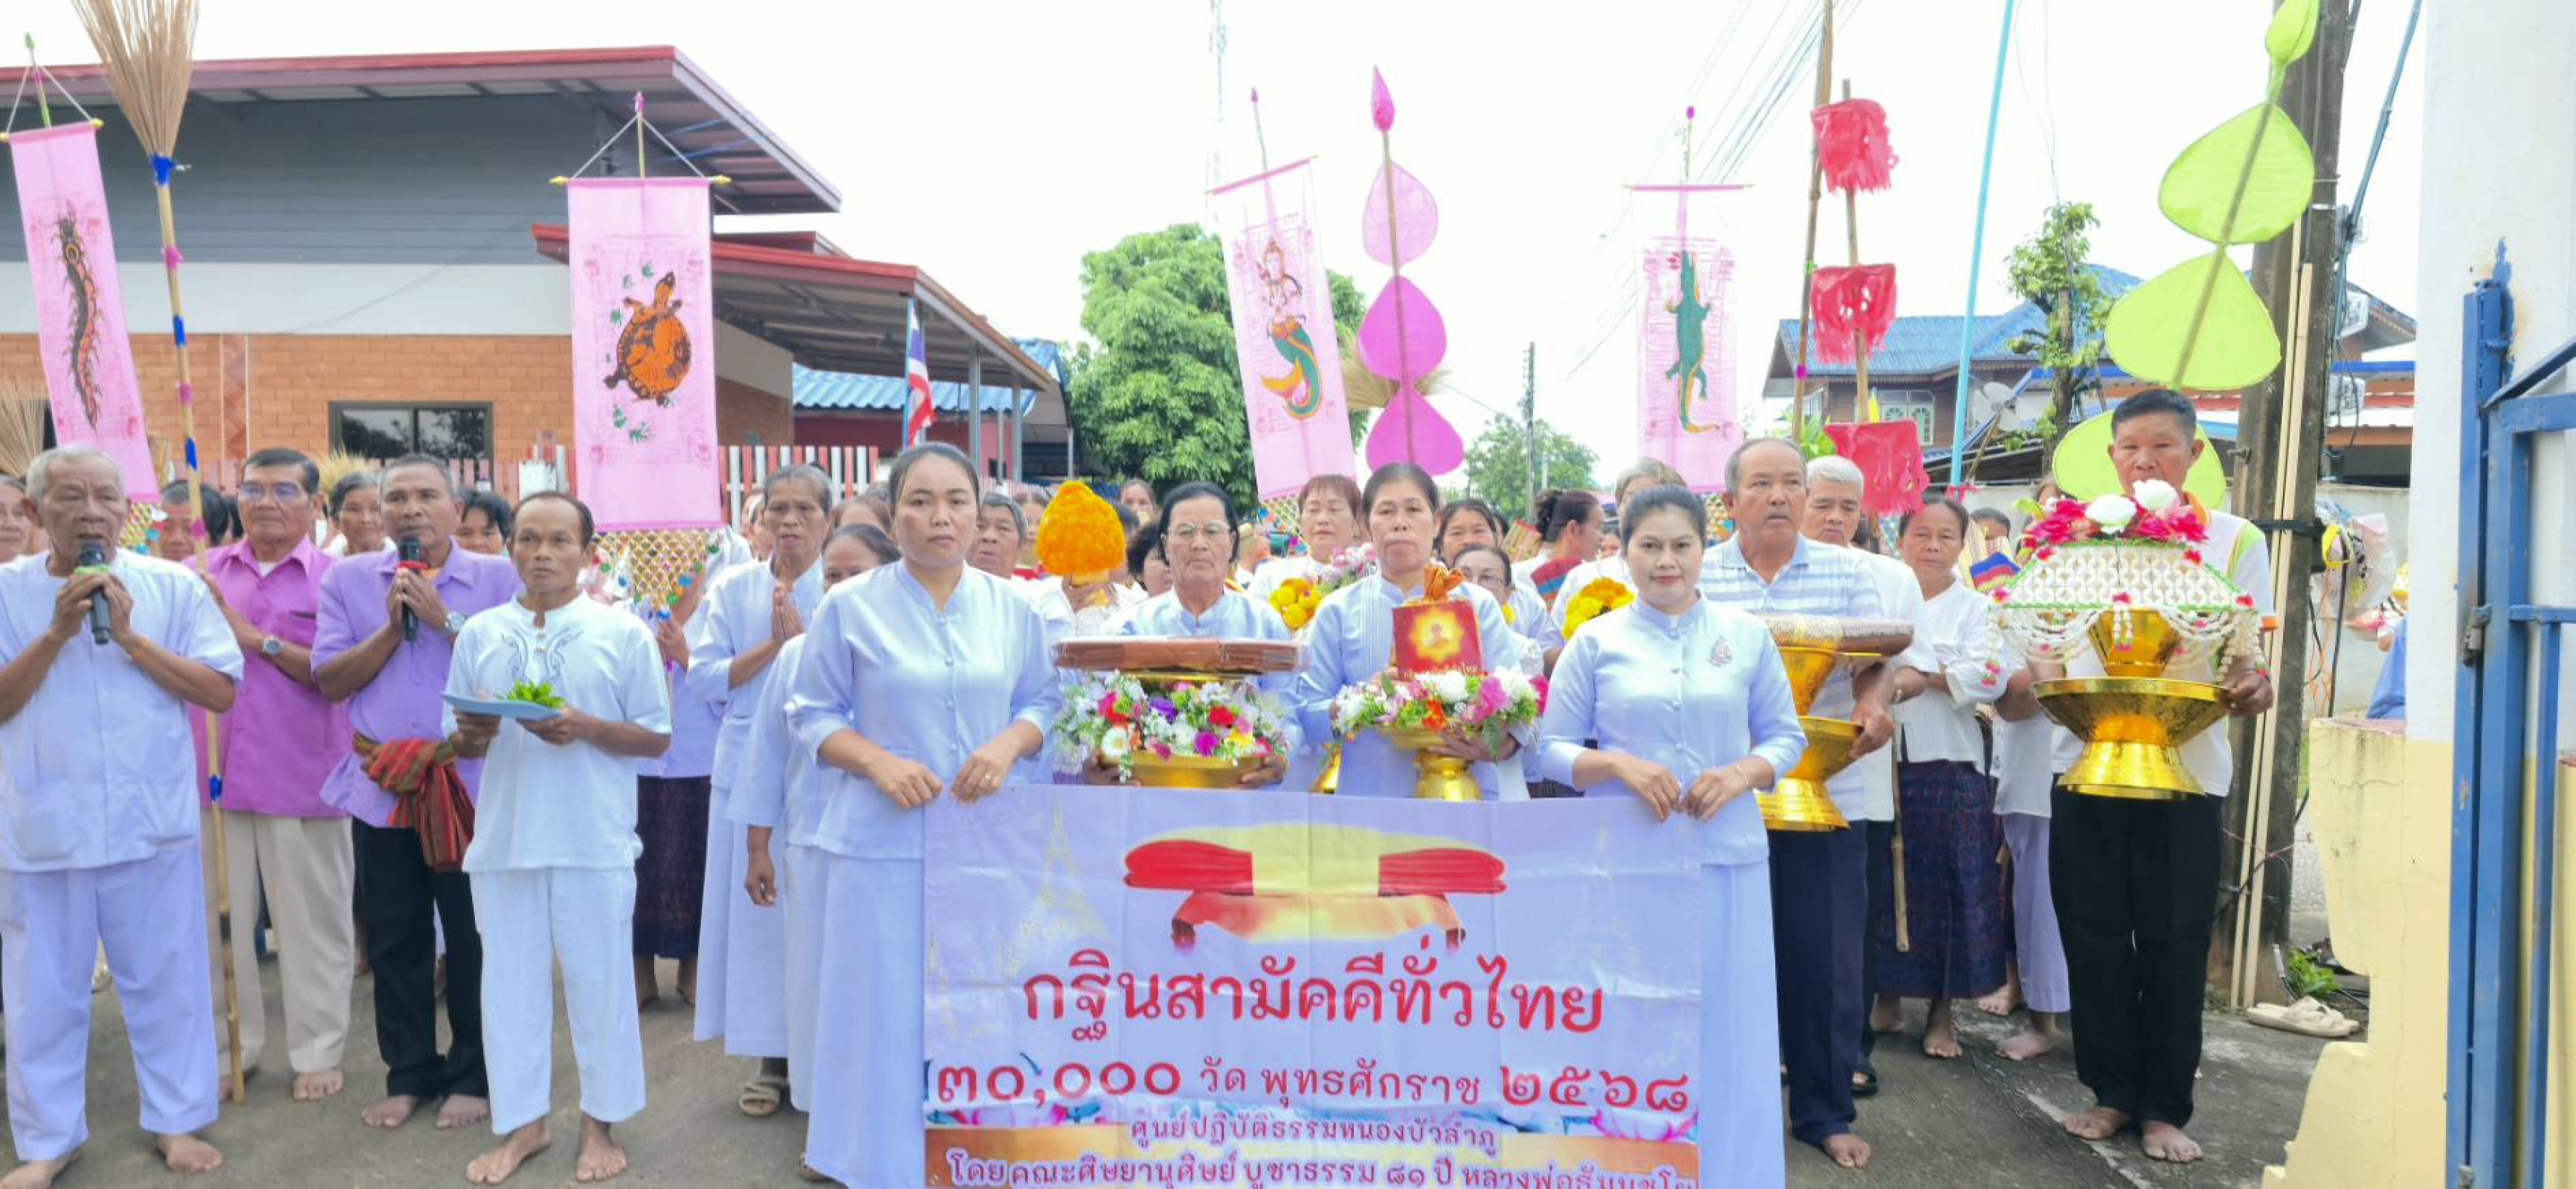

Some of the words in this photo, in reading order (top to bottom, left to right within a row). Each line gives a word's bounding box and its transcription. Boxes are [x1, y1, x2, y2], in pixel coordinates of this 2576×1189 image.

[1023, 935, 1604, 1041] กฐินสามัคคีทั่วไทย
[937, 1061, 1181, 1108] ๓๐,๐๐๐
[1199, 1056, 1246, 1093] วัด
[1262, 1059, 1481, 1108] พุทธศักราช
[1500, 1065, 1689, 1112] ๒๕๖๘
[1435, 1156, 1453, 1185] ปี
